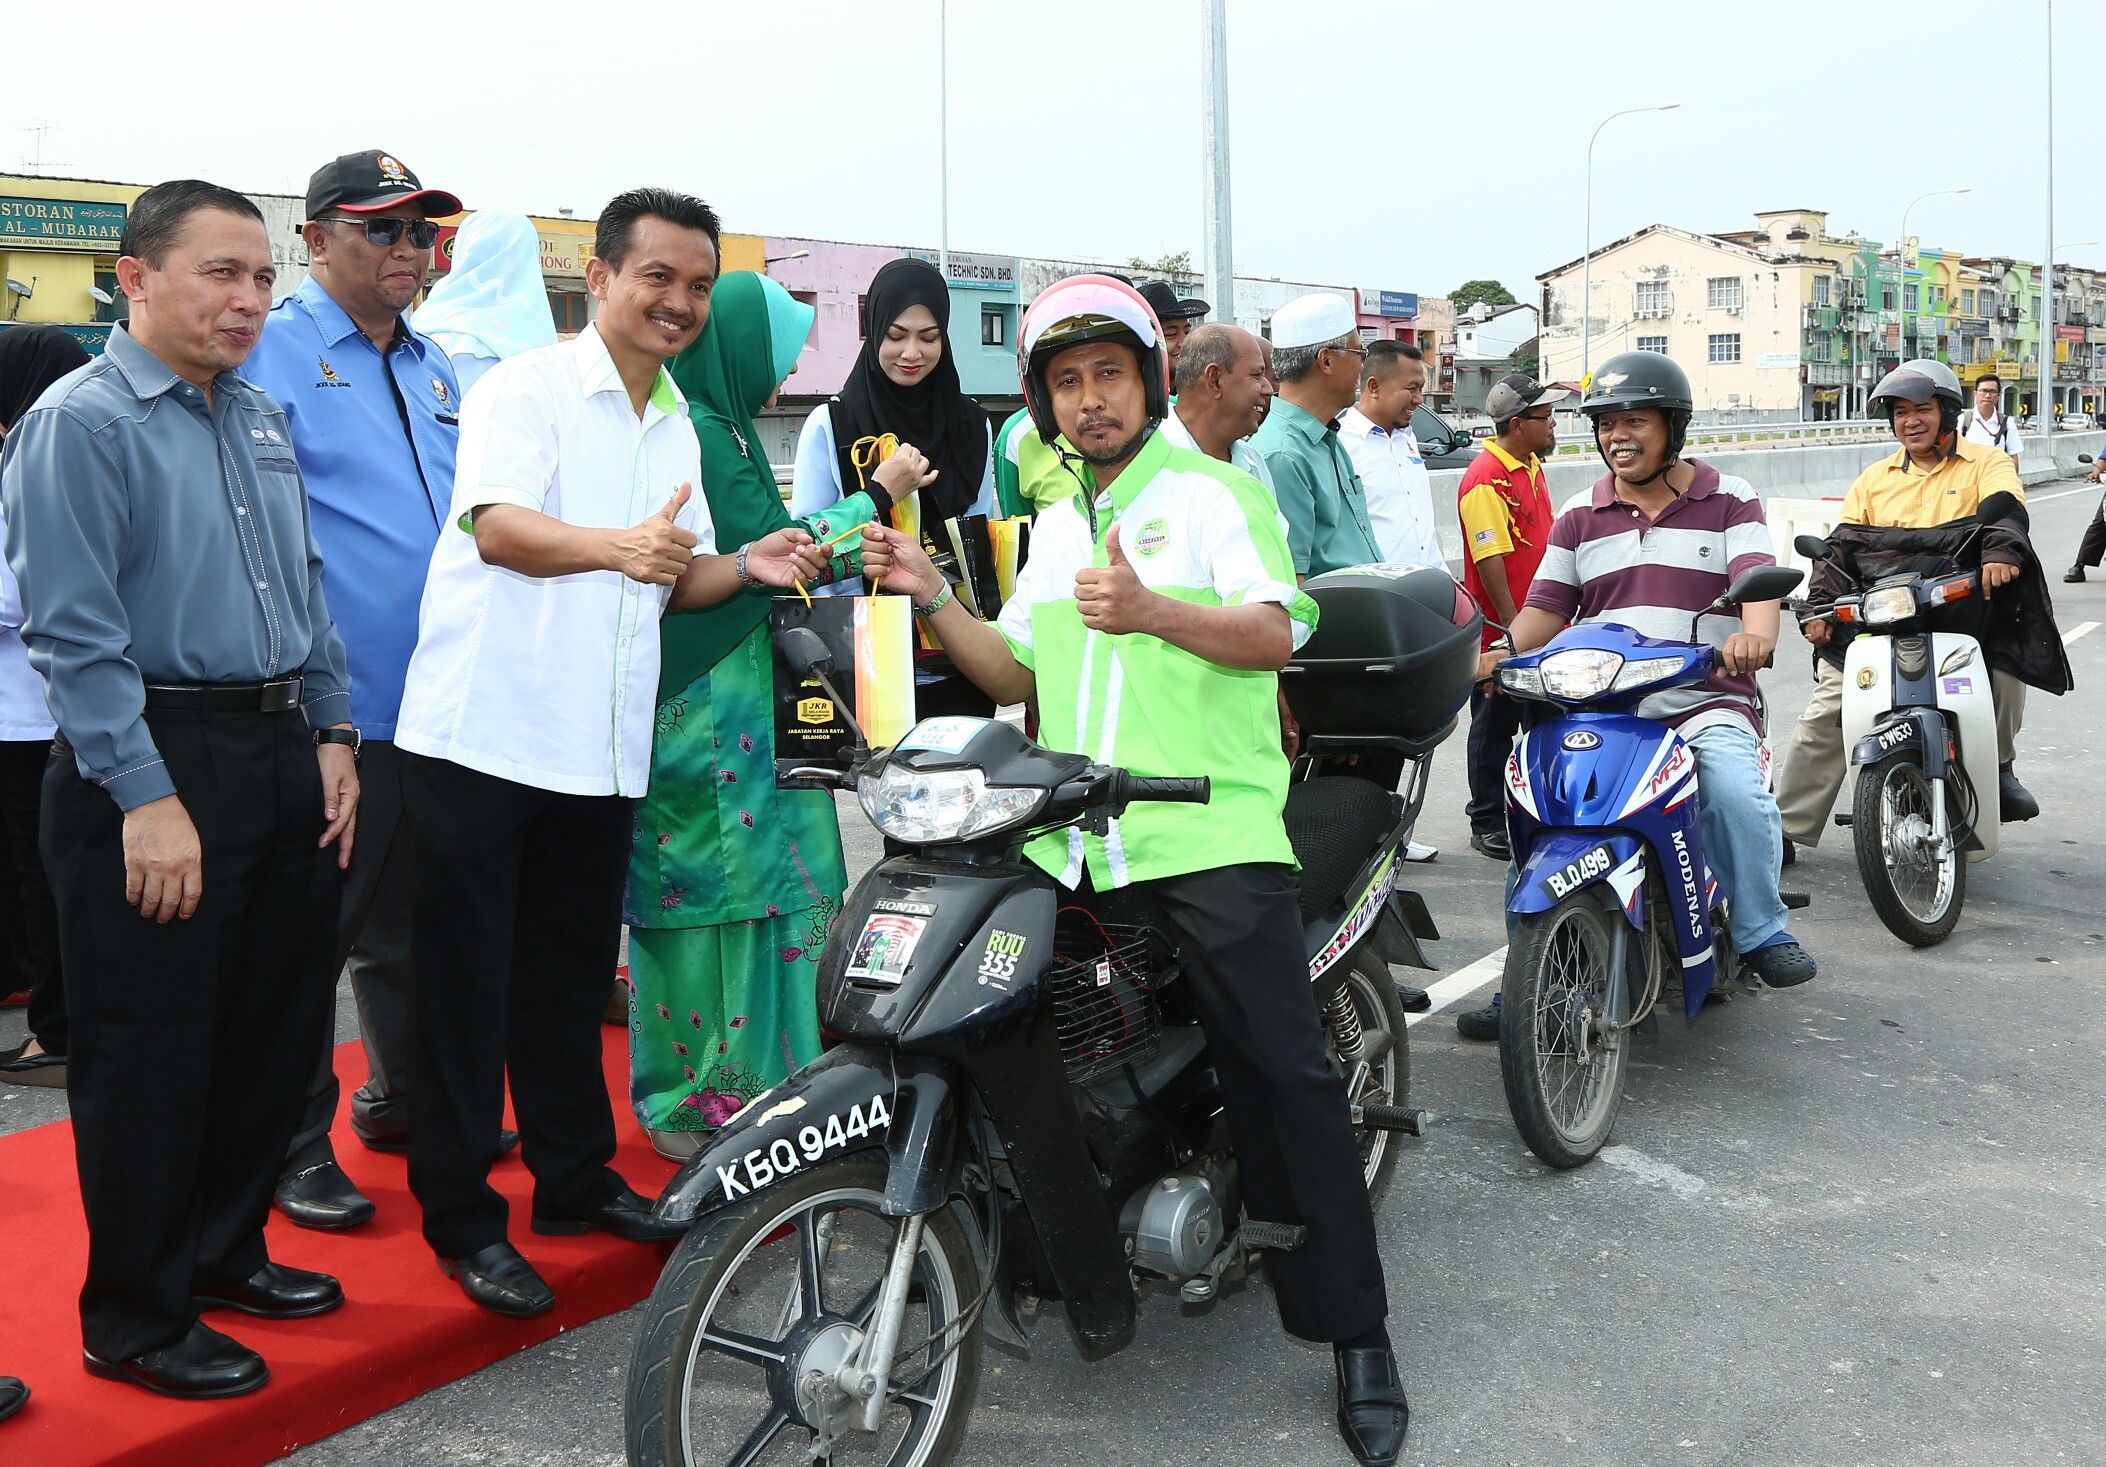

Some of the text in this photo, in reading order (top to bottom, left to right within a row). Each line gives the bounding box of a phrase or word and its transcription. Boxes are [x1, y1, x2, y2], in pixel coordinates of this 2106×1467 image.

[1, 202, 74, 220] STORAN
[42, 222, 121, 238] MUBARAK
[948, 264, 979, 279] TECHNIC
[980, 266, 996, 279] SDN.
[998, 267, 1013, 280] BHD.
[1671, 829, 1704, 939] MODENAS
[875, 900, 931, 914] HONDA
[986, 933, 1026, 958] RUU
[978, 950, 1019, 978] 355
